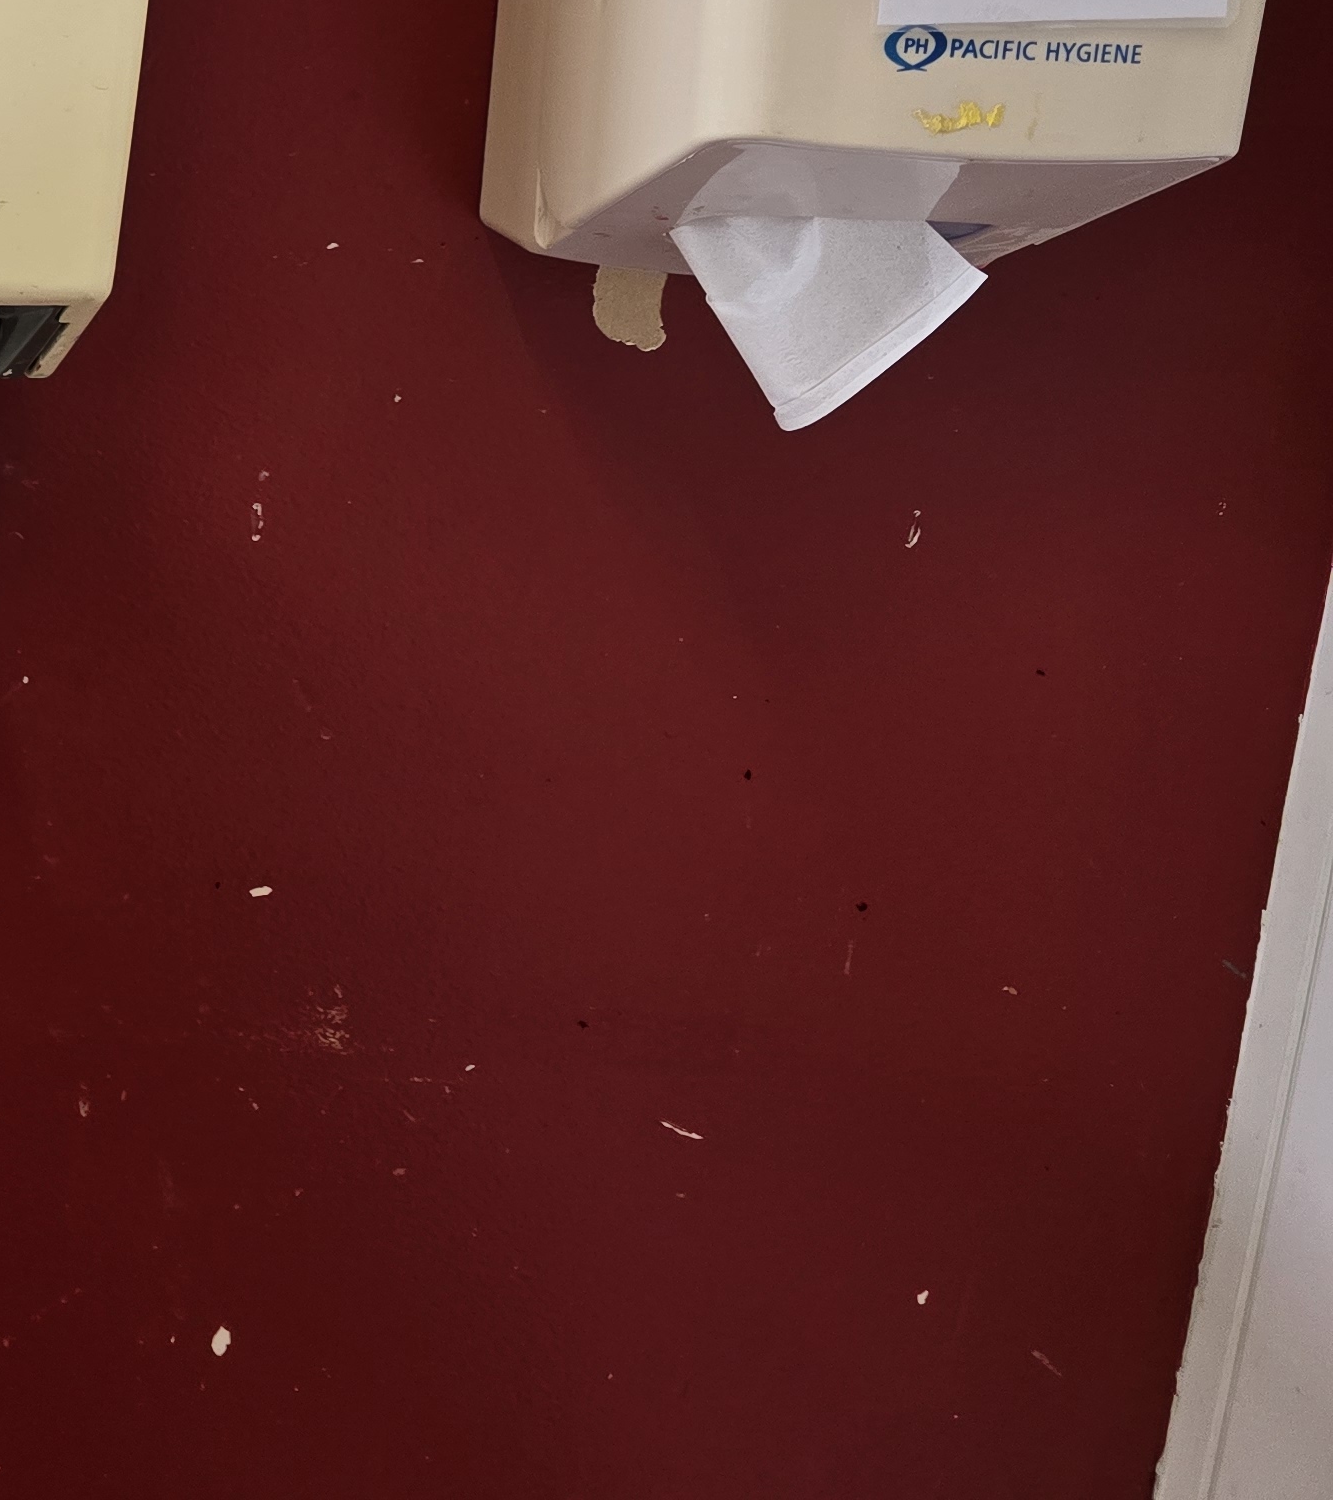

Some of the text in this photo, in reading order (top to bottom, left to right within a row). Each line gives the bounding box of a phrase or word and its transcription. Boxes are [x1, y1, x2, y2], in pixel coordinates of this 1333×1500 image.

[903, 38, 929, 55] PH
[950, 40, 1143, 65] PACIFIC HYGIENE
